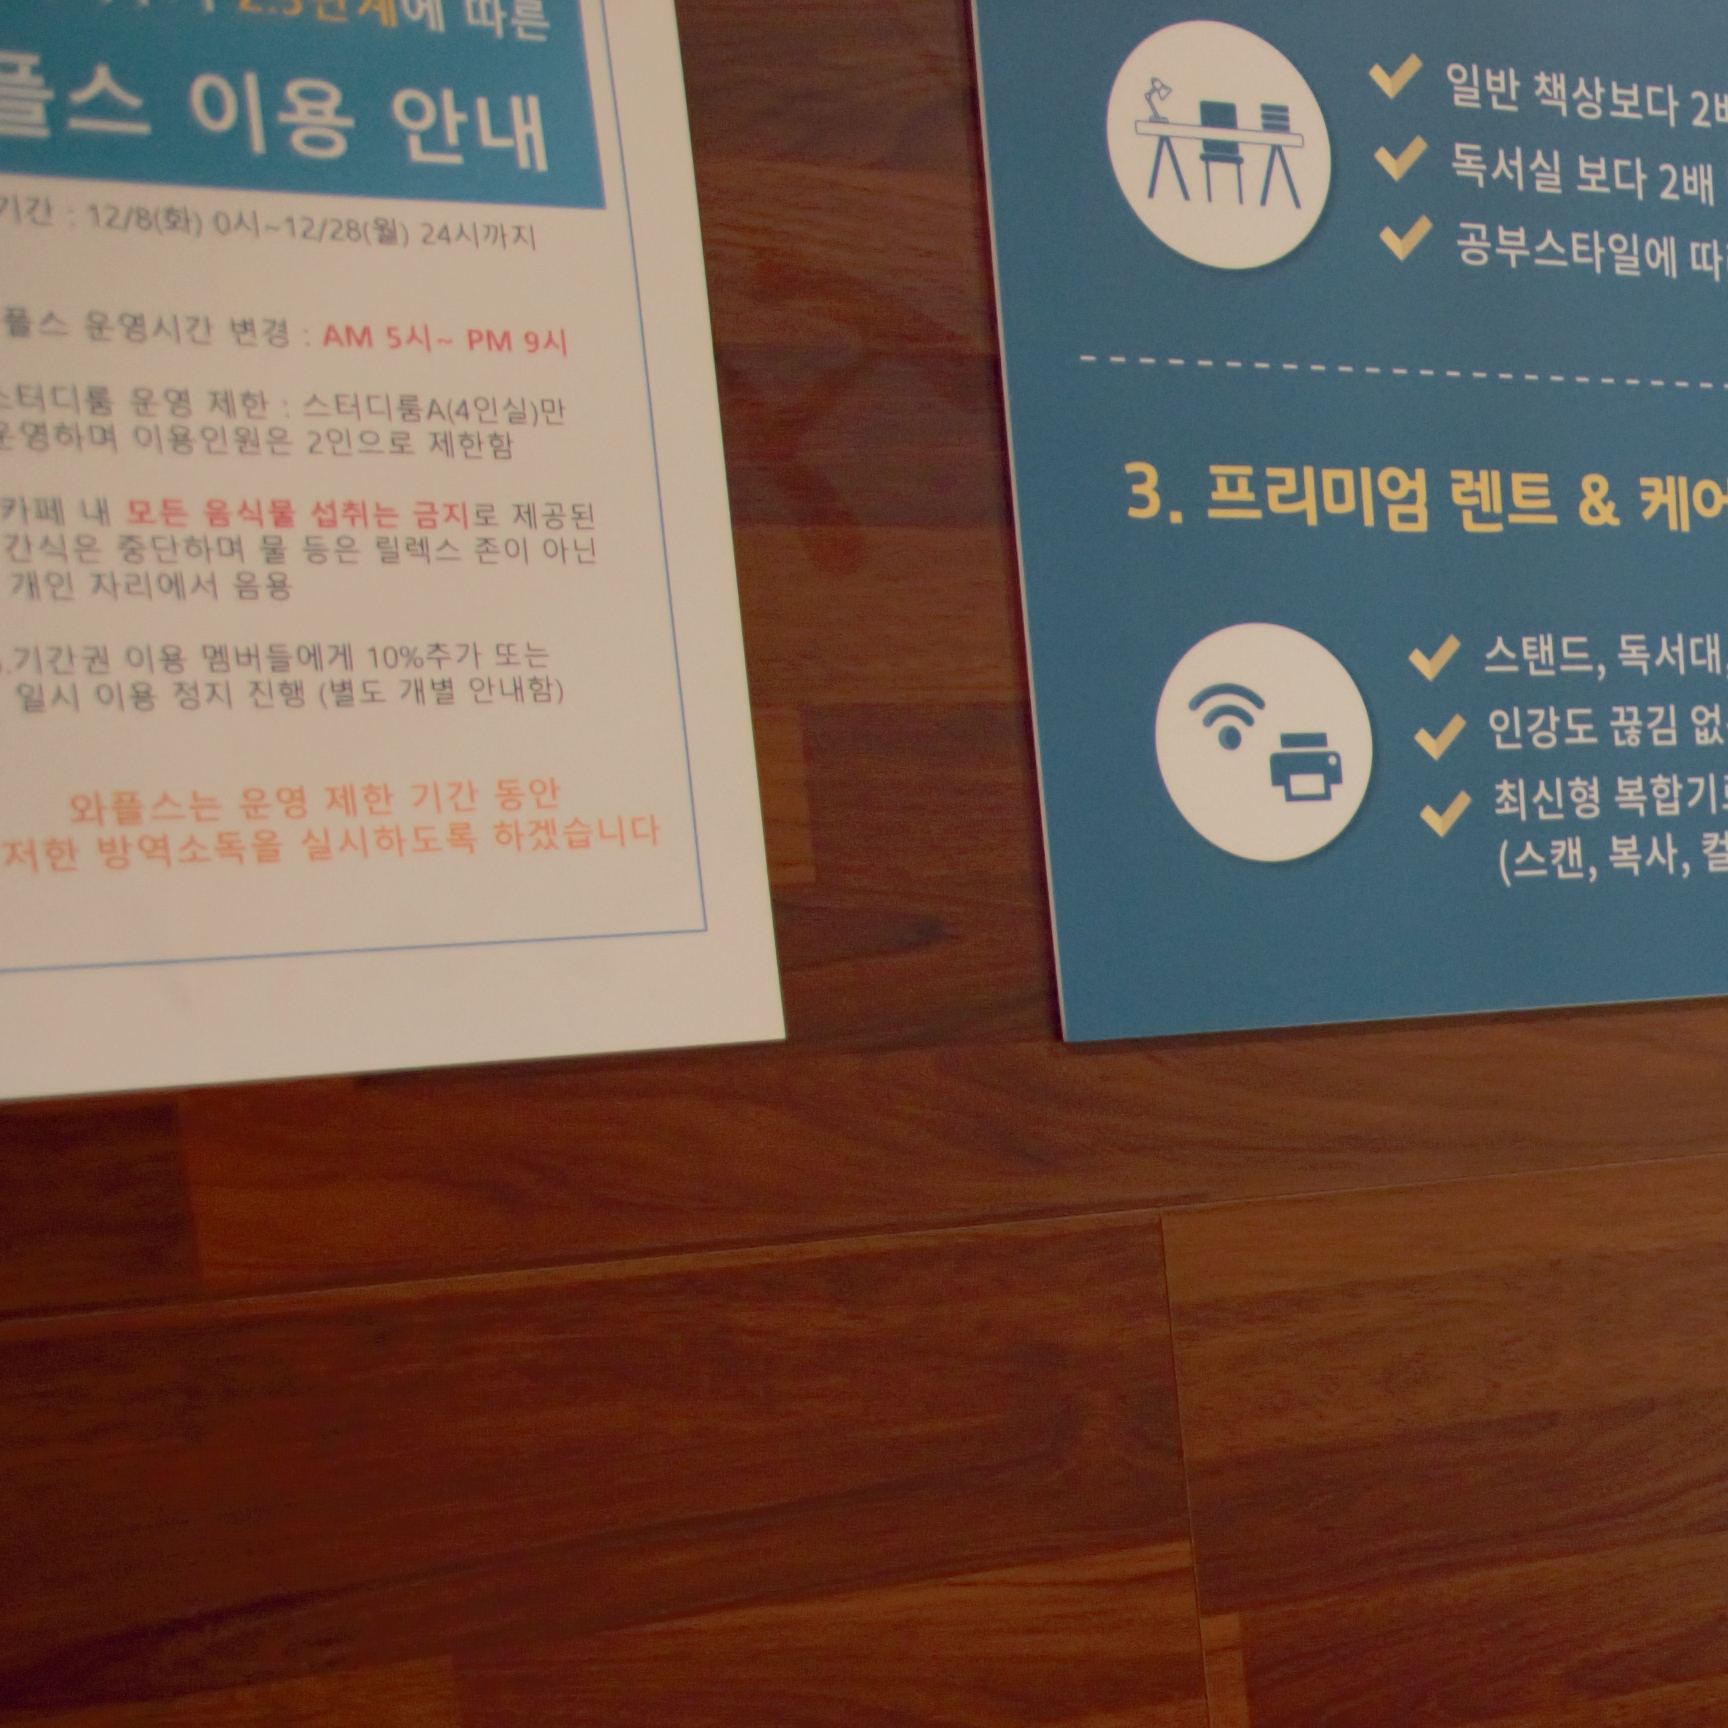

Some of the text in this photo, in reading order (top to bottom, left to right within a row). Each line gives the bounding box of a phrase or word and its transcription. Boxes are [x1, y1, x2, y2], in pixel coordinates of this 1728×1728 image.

[1446, 61, 1519, 111] 일반
[1534, 70, 1679, 128] 책상보다
[190, 70, 355, 160] 이용
[392, 88, 548, 172] 안내
[1452, 142, 1561, 193] 독서실
[1578, 152, 1647, 200] 보다
[1659, 162, 1714, 206] 2배
[420, 221, 535, 250] 24시까지
[1457, 222, 1677, 278] 공부스타일에
[85, 310, 567, 357] 운영시간 AM PM 9시
[207, 389, 267, 420] 제한
[132, 423, 514, 460] 이용인원은 2인으로 제한함
[127, 498, 594, 531] 모든 음식물 섭취는 금지로 제공된
[1124, 462, 1182, 523] 3.
[1207, 464, 1427, 532] 프리미엄
[1451, 469, 1557, 532] 렌트
[1578, 474, 1620, 526] &
[302, 535, 596, 565] 등은 릴렉스 존이 아닌
[90, 571, 293, 601] 자리에서 음용
[200, 642, 550, 673] 멤버들에게 10%추가 또는
[1485, 635, 1606, 680] 스탠드,
[172, 675, 564, 710] 정지 진행 (별도 개별 안내함)
[1488, 704, 1598, 750] 인강도
[1609, 704, 1678, 746] 끊김
[324, 777, 561, 818] 제한 기간 동안
[1494, 776, 1601, 823] 최신형
[98, 814, 661, 871] 방역소독을 실시하도록 하겠습니다
[1500, 836, 1597, 887] (스캔,
[1608, 833, 1692, 878] 복사,
